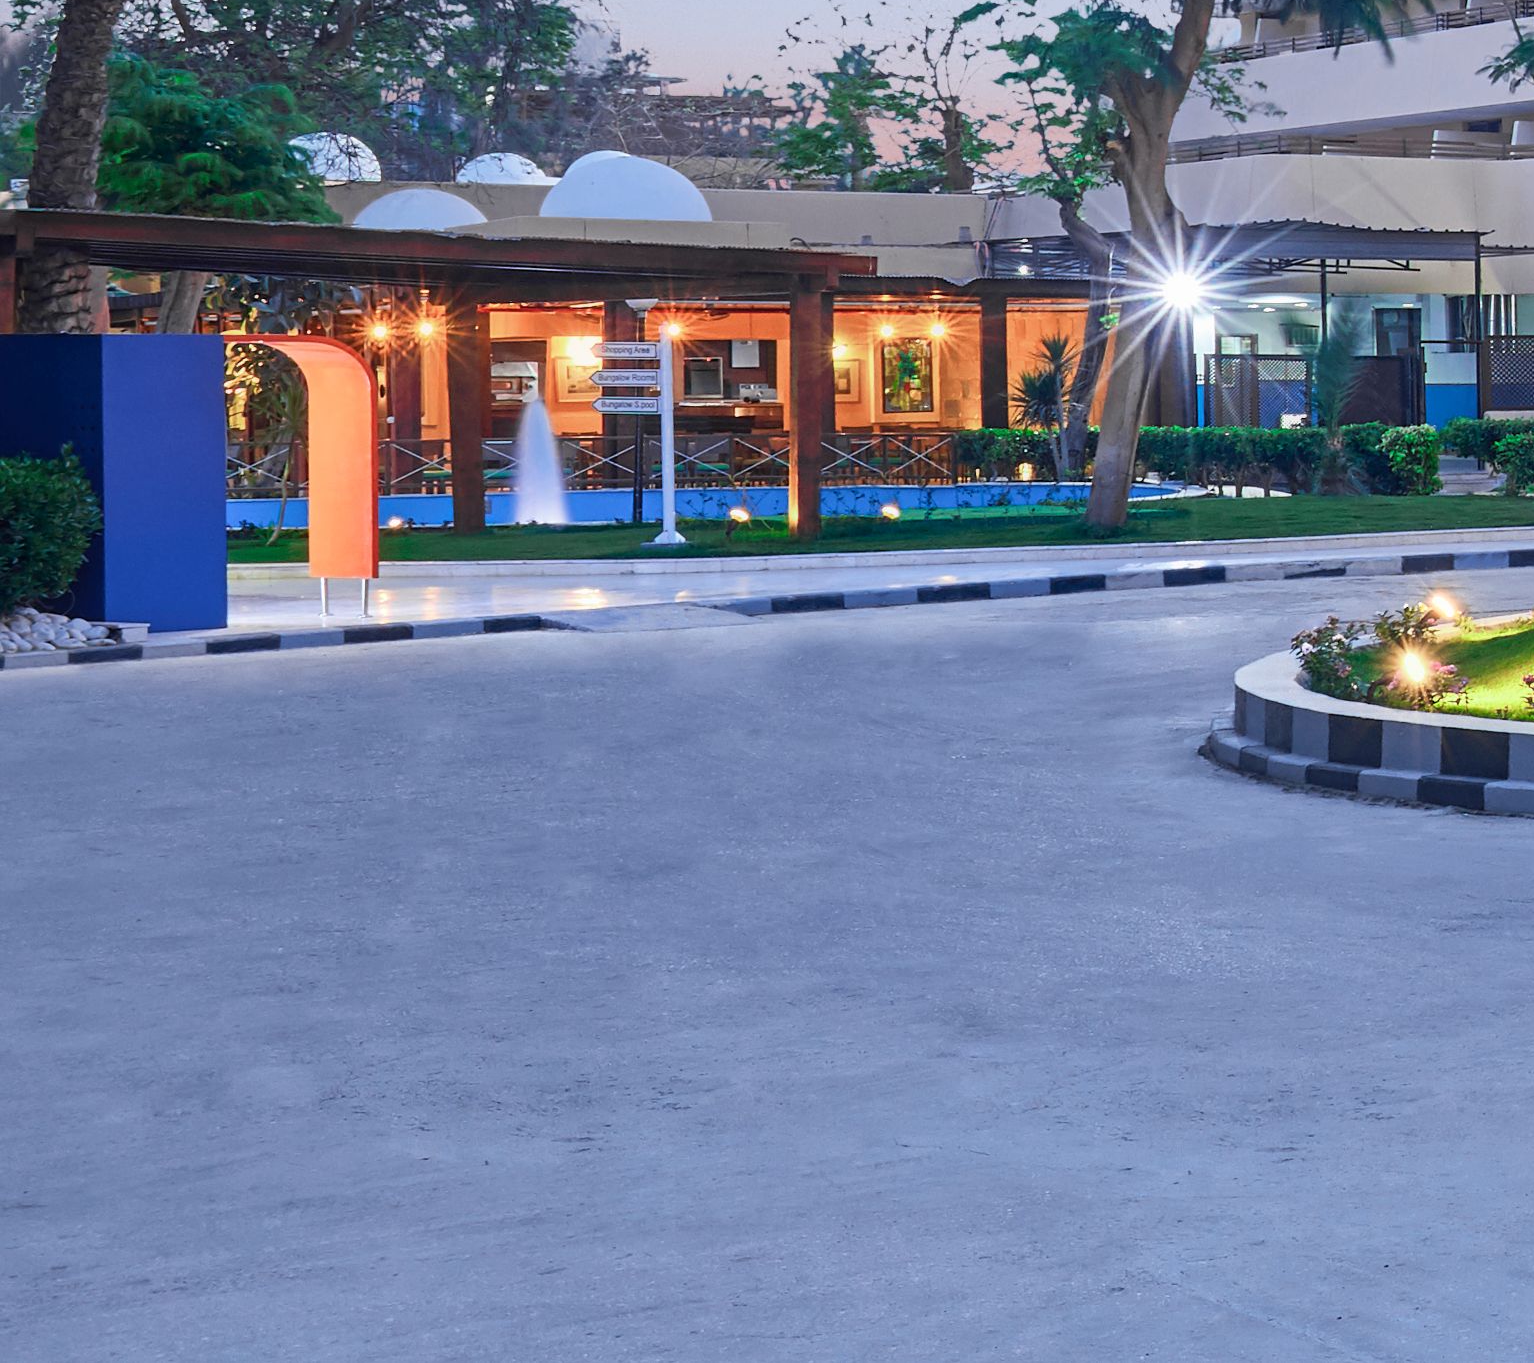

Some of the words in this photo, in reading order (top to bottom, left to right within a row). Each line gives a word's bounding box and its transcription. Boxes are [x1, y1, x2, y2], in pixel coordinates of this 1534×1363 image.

[601, 345, 633, 355] Shopping
[634, 346, 650, 354] Area
[598, 373, 630, 382] Bungalow
[632, 374, 656, 382] Rooms
[601, 401, 633, 409] Bungalow
